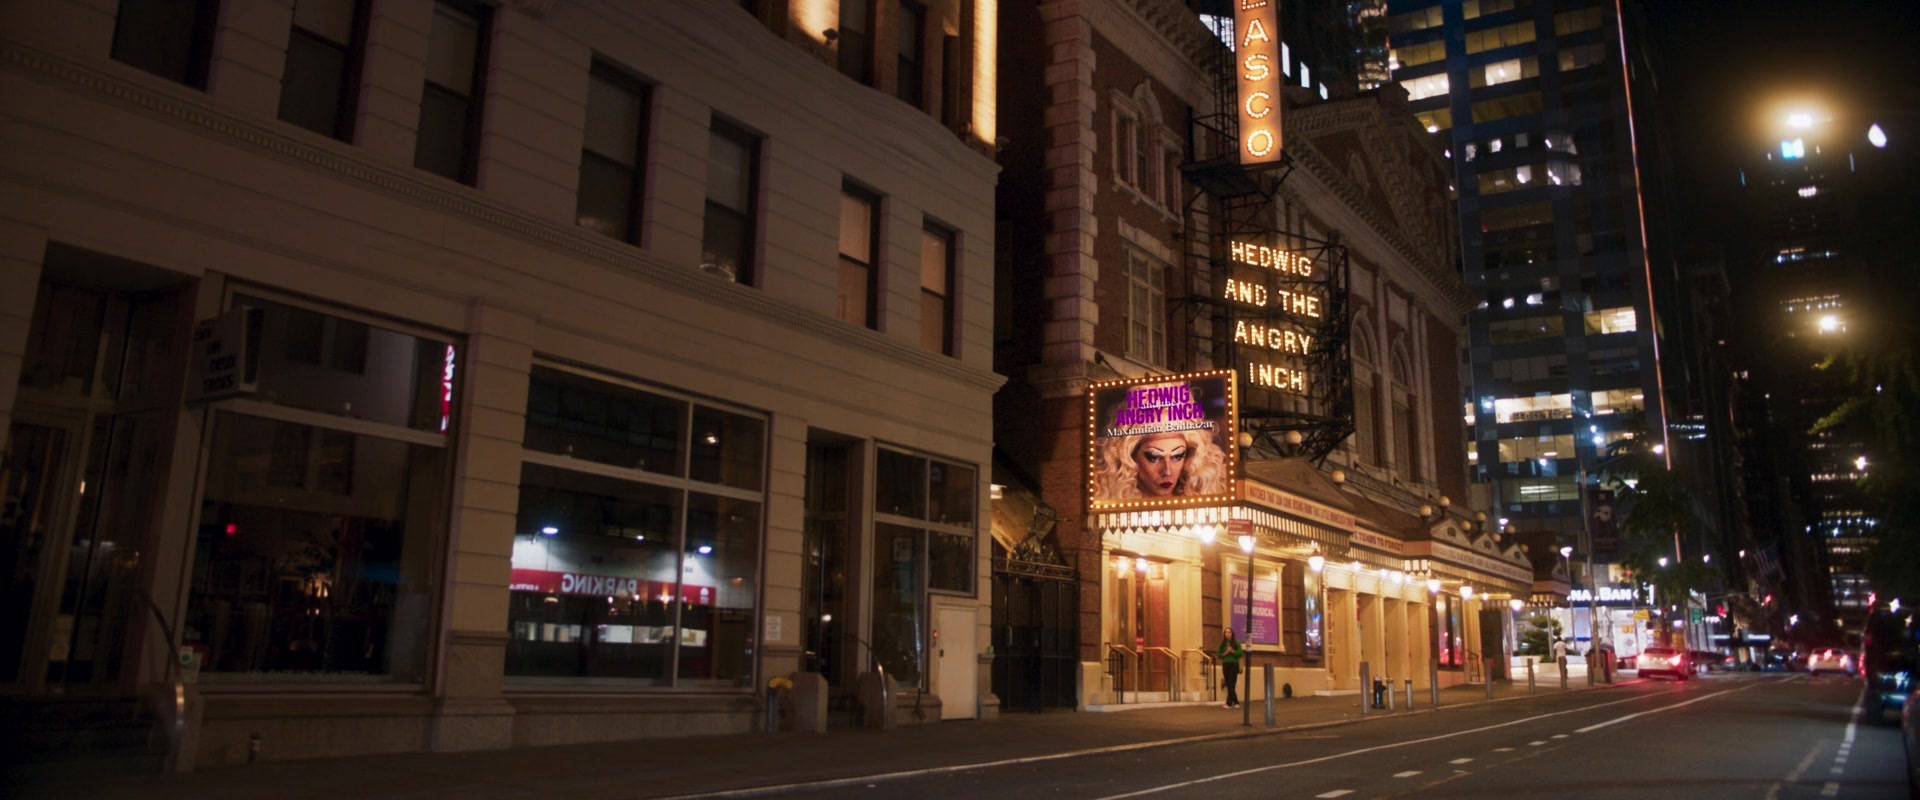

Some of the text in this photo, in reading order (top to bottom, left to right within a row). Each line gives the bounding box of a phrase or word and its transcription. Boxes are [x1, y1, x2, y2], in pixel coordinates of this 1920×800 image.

[1231, 240, 1311, 277] HEDWIG
[1225, 278, 1319, 318] AND THE
[1234, 320, 1311, 355] ANGRY
[1249, 362, 1303, 391] INCH
[1126, 384, 1190, 408] HEDWIG
[1141, 398, 1177, 410] and the
[1116, 401, 1204, 427] ANGRY INCH
[1106, 420, 1214, 437] Maximilian Balthazar
